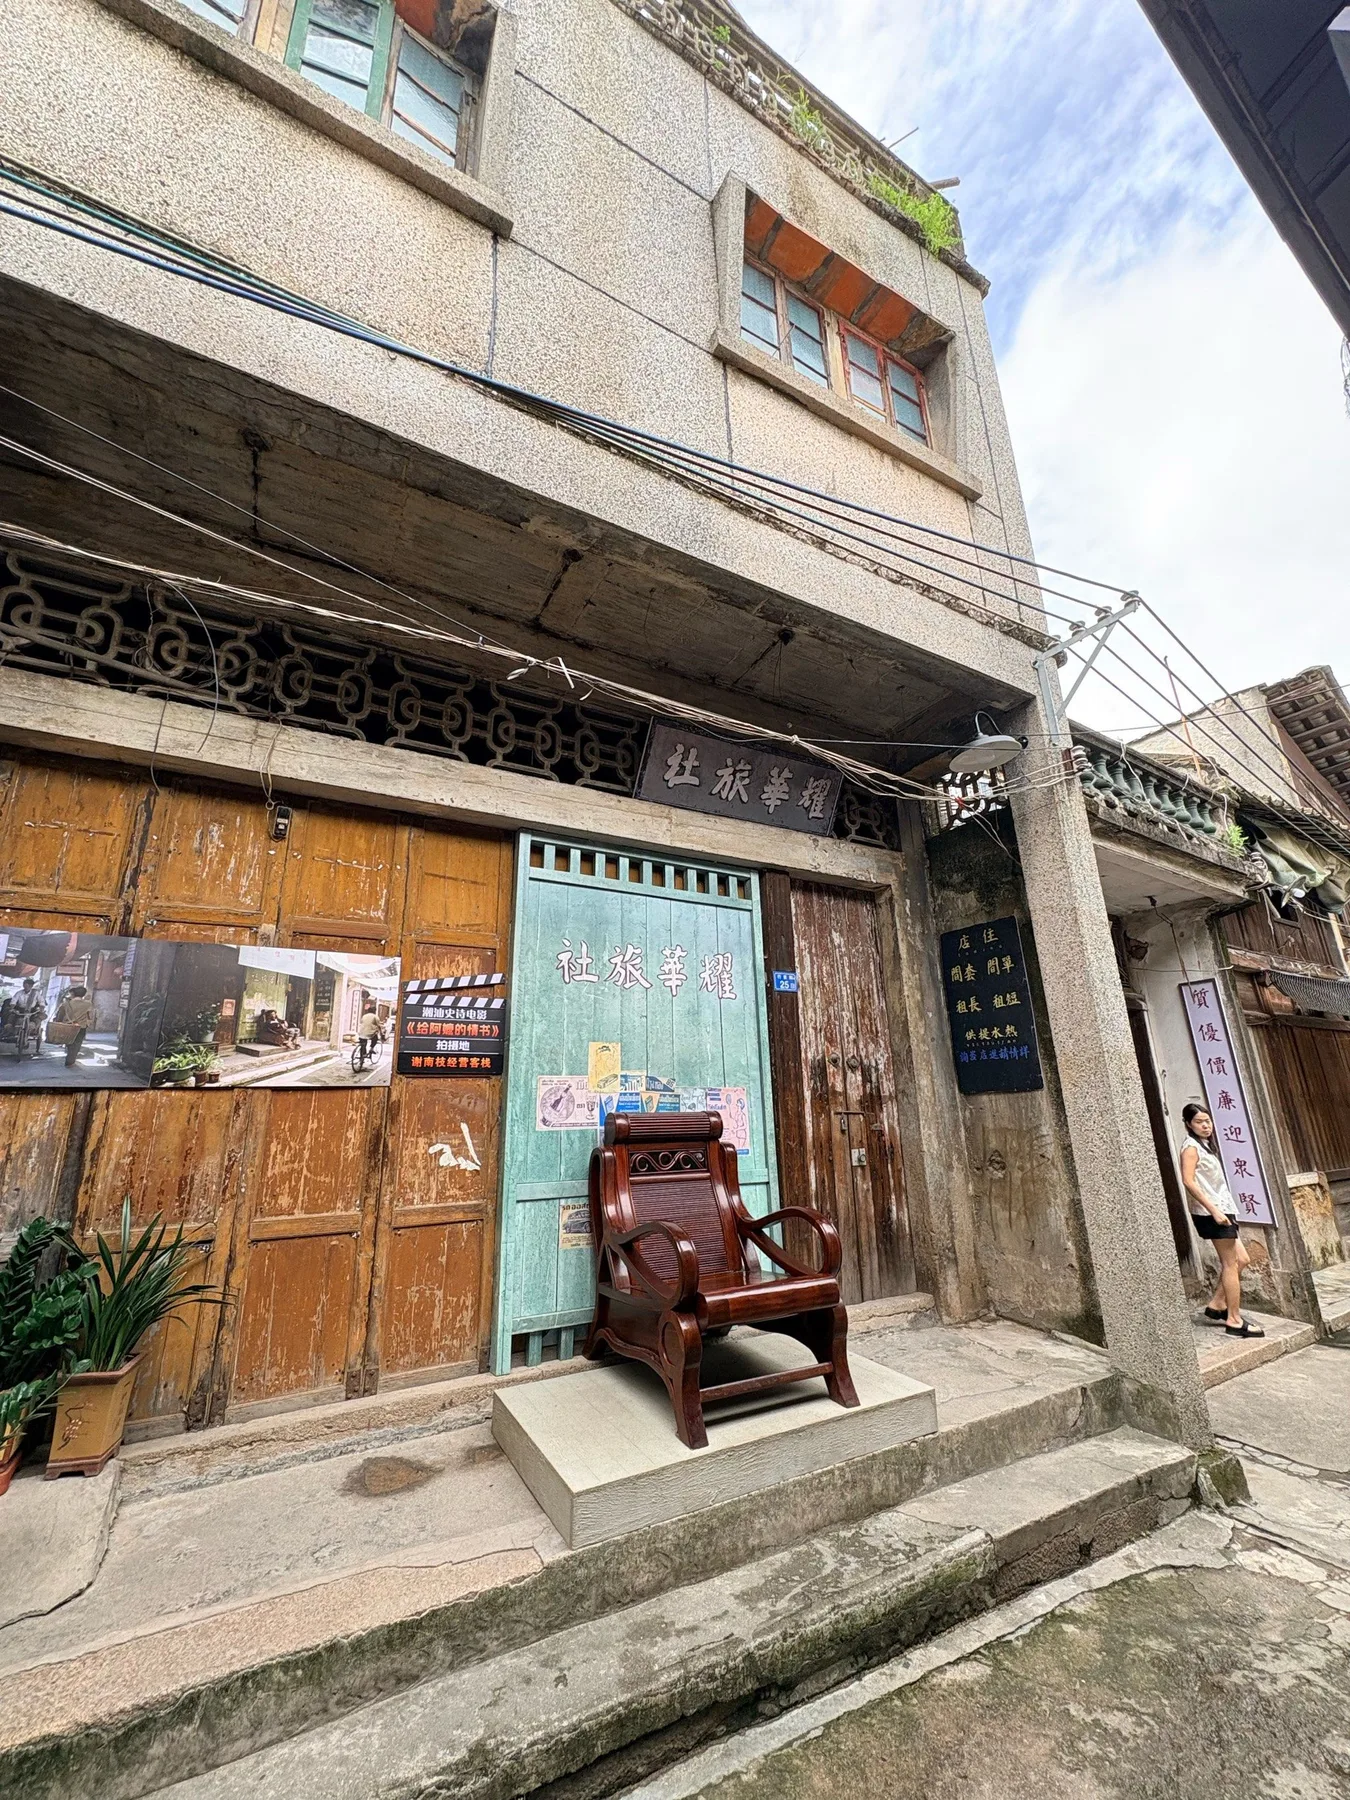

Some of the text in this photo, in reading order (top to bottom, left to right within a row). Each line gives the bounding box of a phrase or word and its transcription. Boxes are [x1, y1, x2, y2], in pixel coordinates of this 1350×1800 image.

[422, 1007, 487, 1020] 潮汕史诗电影
[436, 1040, 470, 1051] 拍摄地
[411, 1056, 492, 1069] 谢南枝经营客栈
